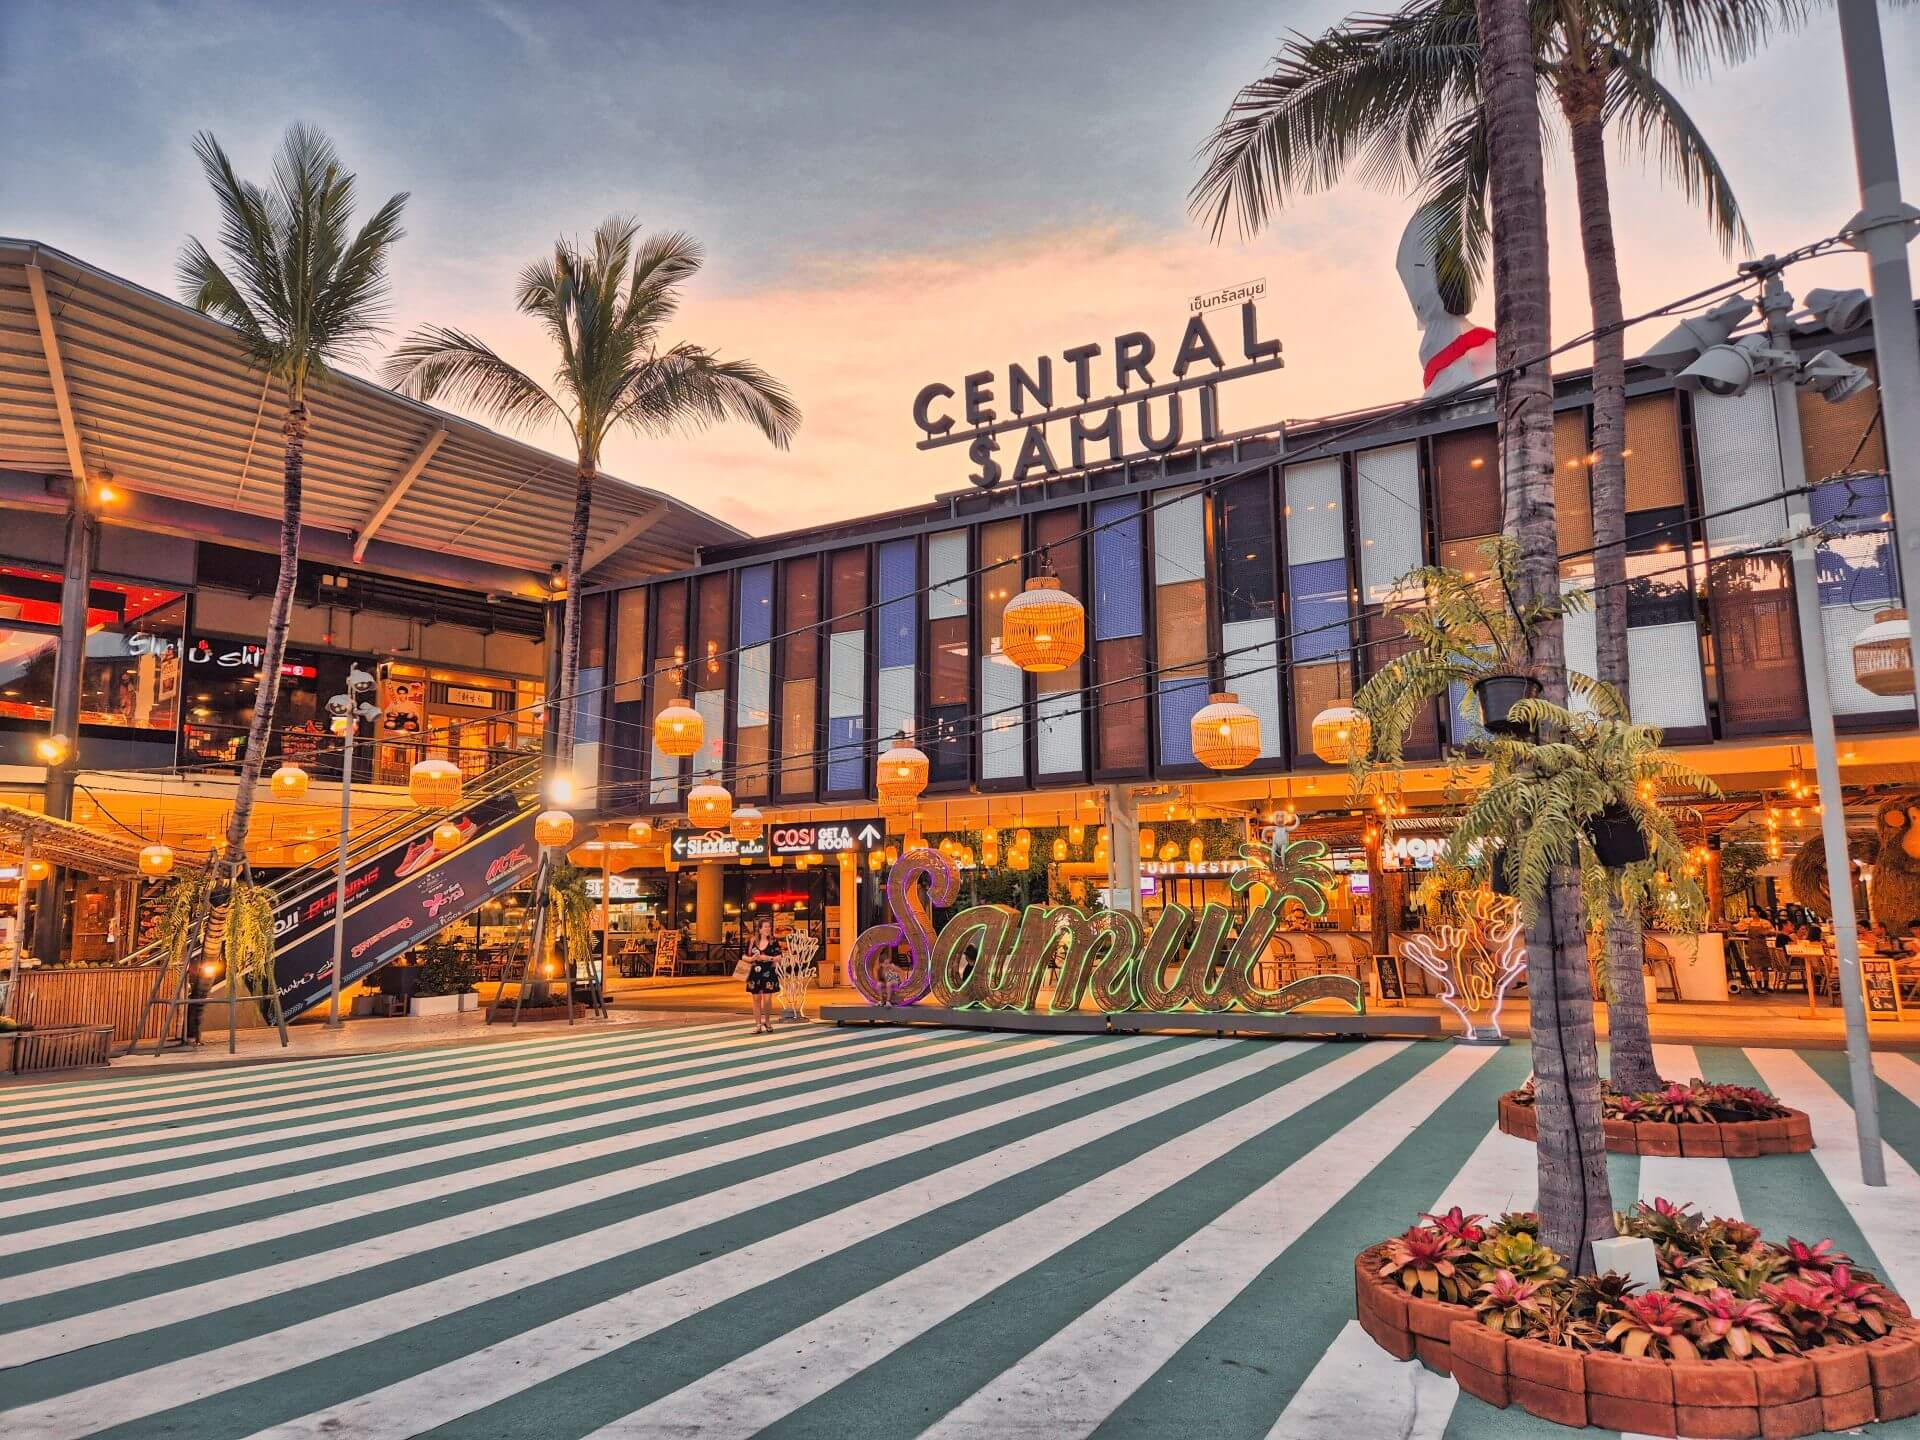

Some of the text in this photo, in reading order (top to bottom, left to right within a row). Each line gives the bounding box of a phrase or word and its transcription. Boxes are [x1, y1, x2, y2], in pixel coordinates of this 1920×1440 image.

[1190, 283, 1264, 312] เซ็นทรัลสมุย
[913, 302, 1283, 434] CENTRAL
[968, 383, 1220, 489] SAMUI
[773, 828, 815, 846] COSI
[818, 827, 850, 839] GET A
[687, 839, 739, 855] Sizzler
[818, 837, 853, 850] ROOM
[1140, 861, 1175, 874] FUJI
[848, 839, 1366, 1014] Samui
